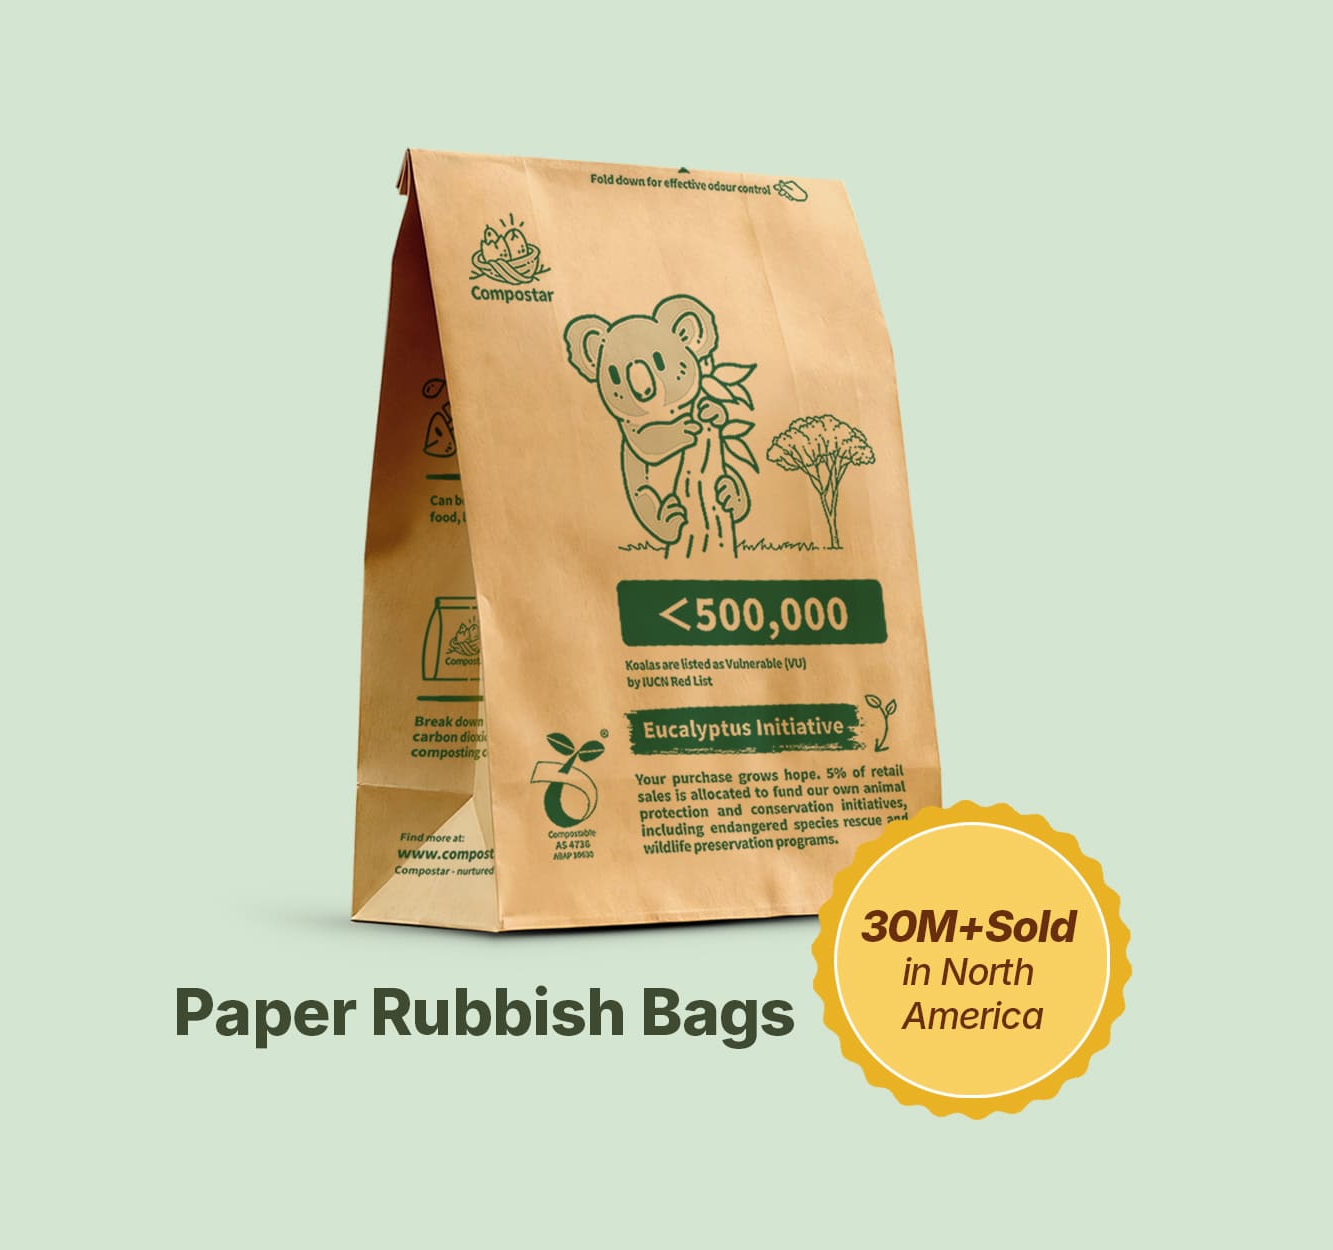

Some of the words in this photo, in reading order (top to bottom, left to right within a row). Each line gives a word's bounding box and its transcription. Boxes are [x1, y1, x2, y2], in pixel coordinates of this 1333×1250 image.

[591, 174, 614, 184] Fold
[616, 175, 645, 186] down
[647, 177, 661, 187] for
[664, 178, 706, 190] effective
[708, 181, 736, 192] odour
[738, 185, 771, 195] control
[471, 285, 554, 304] Compostar
[430, 495, 452, 506] Can
[455, 494, 465, 505] b
[430, 512, 460, 525] food,
[659, 597, 848, 640] <500,000
[625, 660, 660, 671] Koalas
[663, 661, 679, 670] are
[681, 658, 711, 670] listed
[713, 661, 724, 669] as
[725, 658, 782, 669] Vulnerable
[785, 657, 807, 671] (VU)
[627, 677, 640, 689] by
[643, 676, 668, 688] IUCN
[671, 676, 691, 687] Red
[693, 675, 713, 686] List
[415, 716, 452, 727] Break
[455, 716, 483, 727] down
[643, 719, 752, 741] Eucalyptus
[756, 716, 843, 736] Initiative
[413, 731, 457, 742] carbon
[411, 746, 480, 760] composting
[635, 774, 666, 785] Your
[672, 771, 733, 787] purchase
[738, 770, 779, 785] grows
[784, 768, 820, 783] hope.
[826, 767, 846, 779] 5%
[853, 766, 865, 778] of
[871, 764, 903, 777] retail
[638, 789, 671, 802] sales
[675, 789, 686, 801] is
[691, 786, 750, 801] allocated
[755, 786, 768, 798] to
[773, 785, 802, 798] fund
[807, 786, 829, 796] our
[833, 784, 859, 795] own
[864, 781, 905, 794] animal
[640, 805, 708, 822] protection
[718, 804, 742, 816] and
[751, 800, 834, 815] conservation
[841, 798, 908, 811] initiatives,
[641, 821, 704, 838] including
[711, 818, 788, 835] endangered
[794, 815, 839, 832] species
[844, 815, 882, 827] rescue
[400, 833, 424, 842] Find
[644, 839, 691, 854] wildlife
[694, 835, 773, 854] preservation
[776, 834, 838, 850] programs.
[556, 841, 567, 850] AS
[398, 848, 494, 862] www.compost
[395, 866, 450, 877] Compostar
